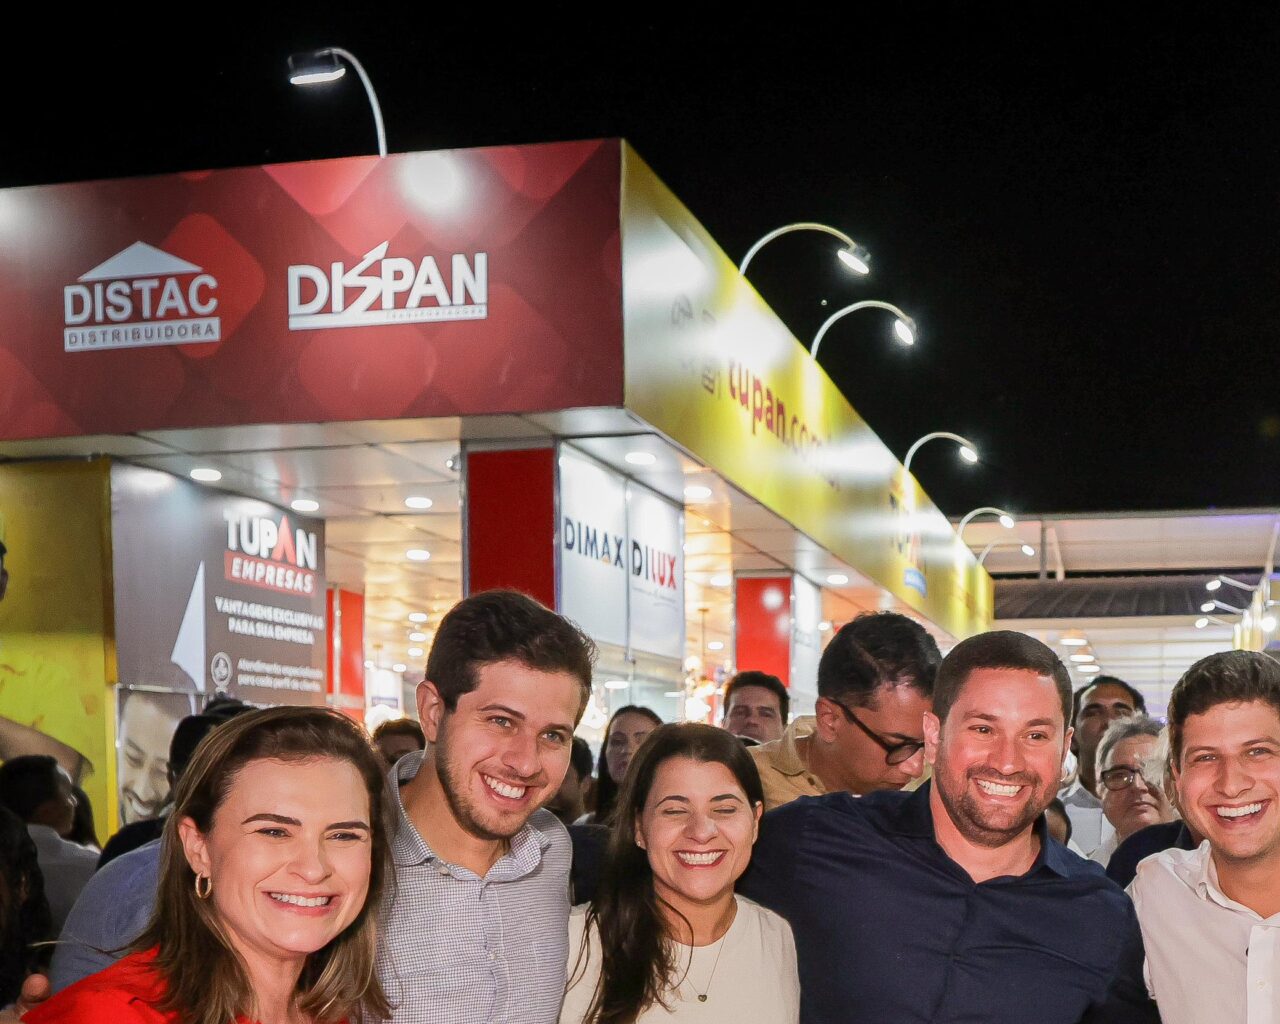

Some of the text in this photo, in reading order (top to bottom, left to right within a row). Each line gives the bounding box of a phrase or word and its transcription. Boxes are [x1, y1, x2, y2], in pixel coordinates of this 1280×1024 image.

[64, 274, 219, 326] DISTAC
[288, 241, 488, 315] DISPAN
[68, 324, 215, 346] DISTRIBUIDORA
[223, 510, 318, 570] TUPAN
[564, 516, 624, 569] DIMAX
[632, 539, 677, 590] DILUX
[231, 557, 314, 594] EMPRESAS
[228, 616, 256, 637] PARA
